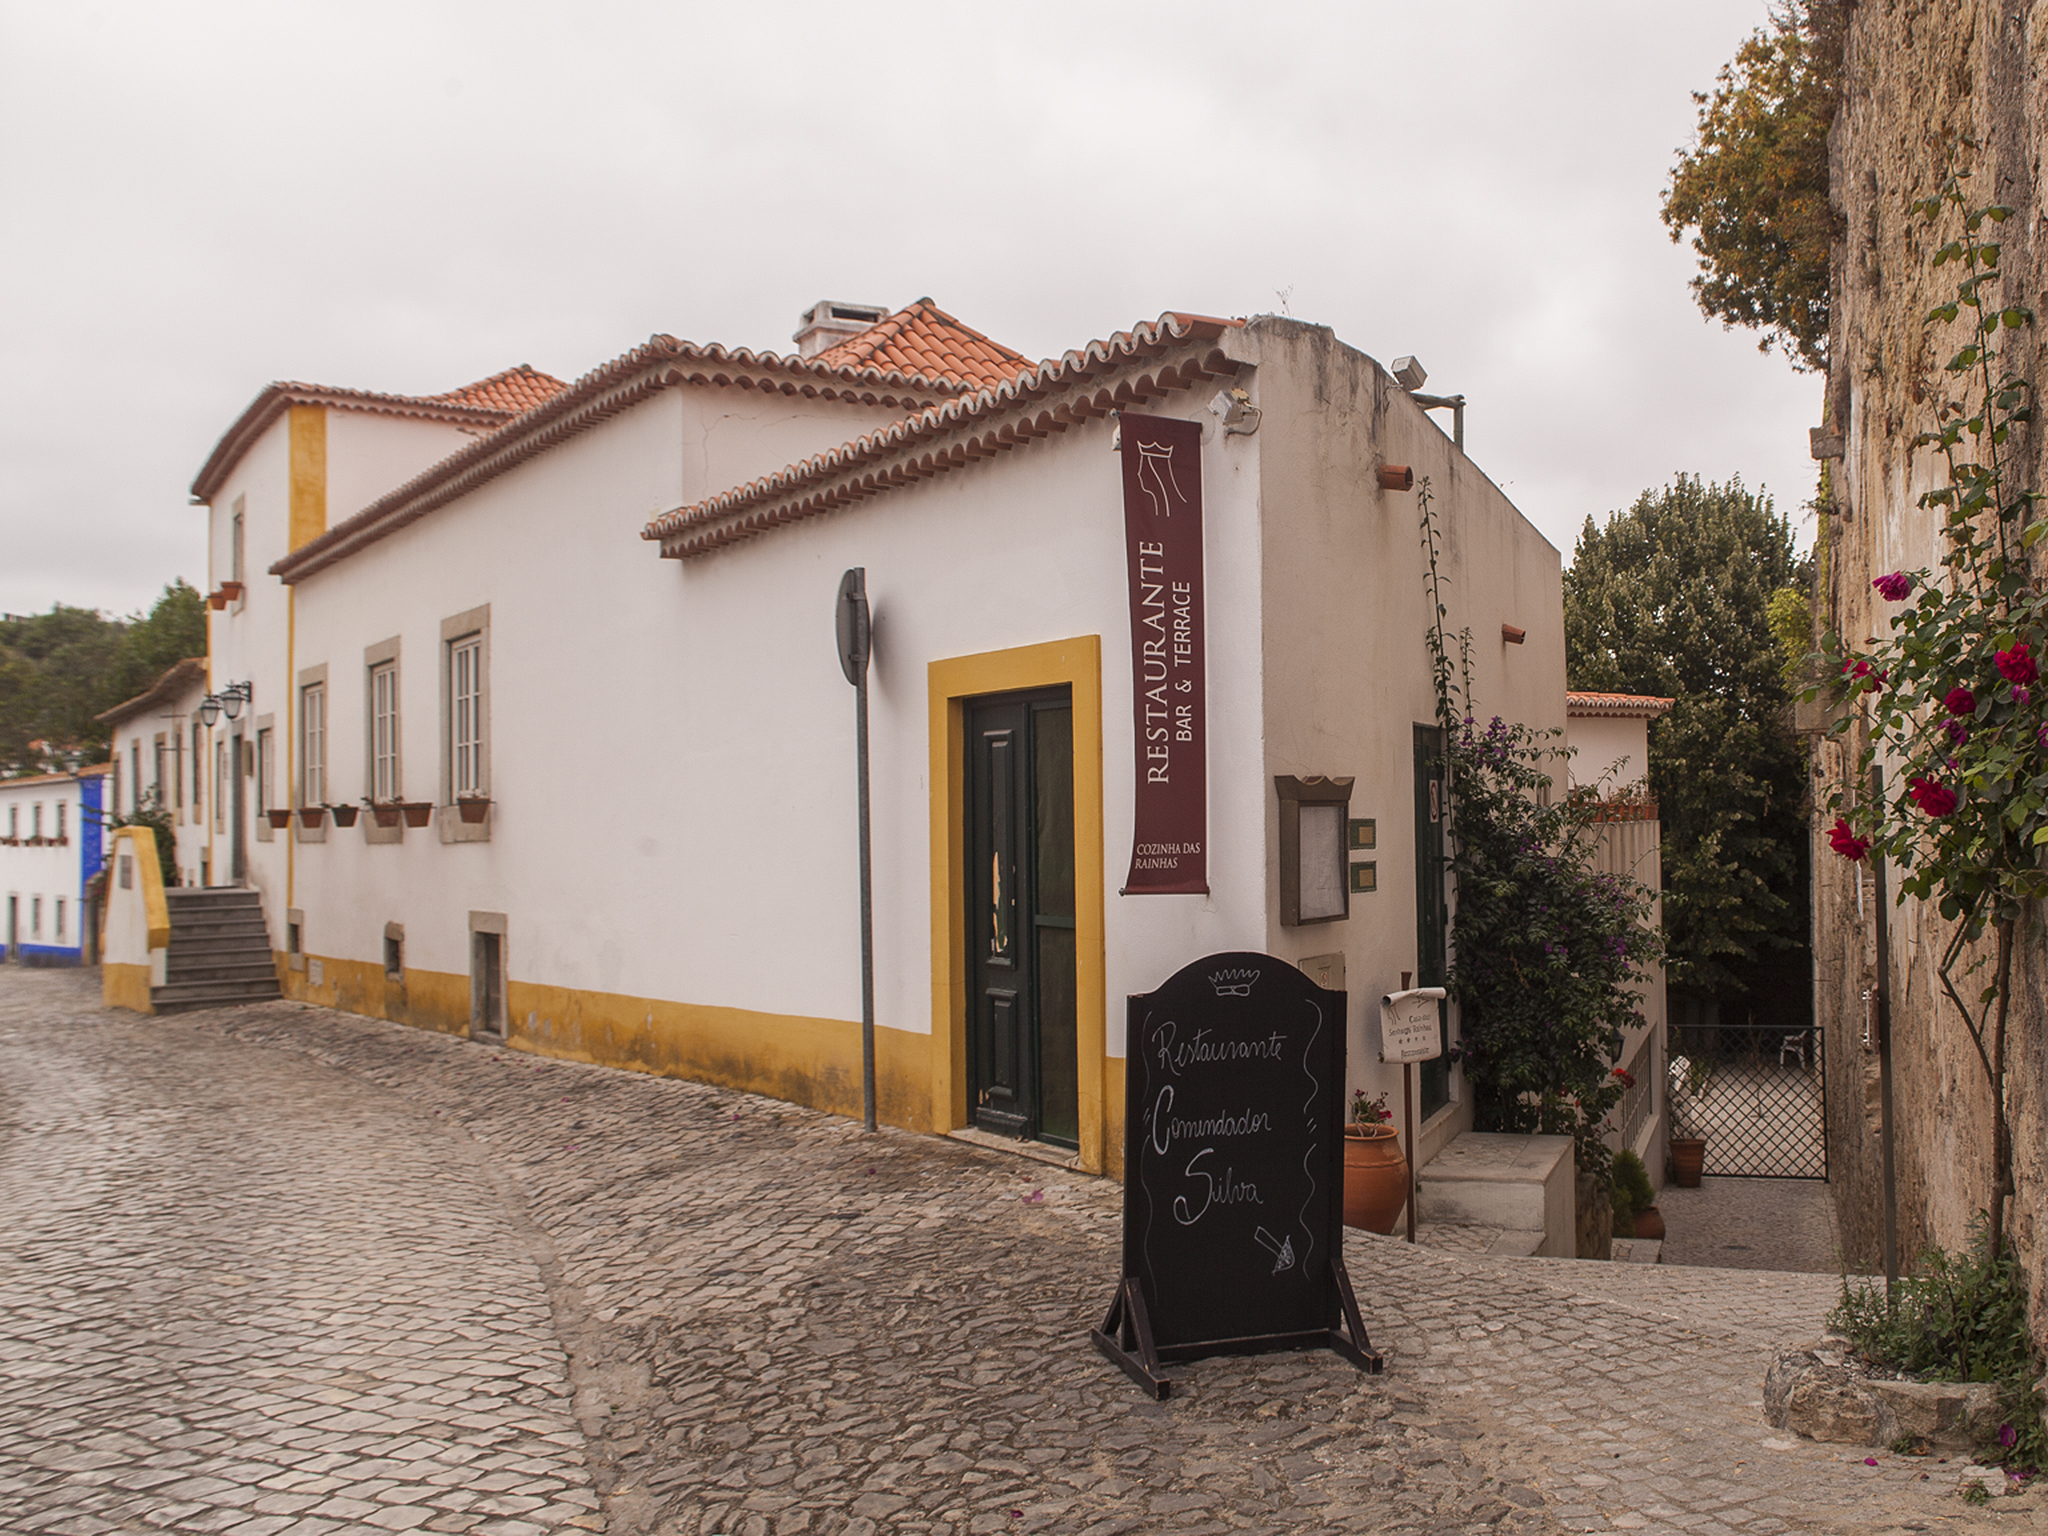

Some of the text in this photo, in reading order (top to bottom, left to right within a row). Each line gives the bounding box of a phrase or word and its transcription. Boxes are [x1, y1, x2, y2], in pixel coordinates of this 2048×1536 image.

[1140, 541, 1169, 784] RESTAURANTE
[1173, 582, 1193, 742] BAR & TERRACE
[1136, 859, 1178, 869] RAINHAS
[1137, 842, 1201, 855] COZINHA DAS
[1151, 1021, 1288, 1076] Restaurante
[1173, 1148, 1264, 1225] Silva
